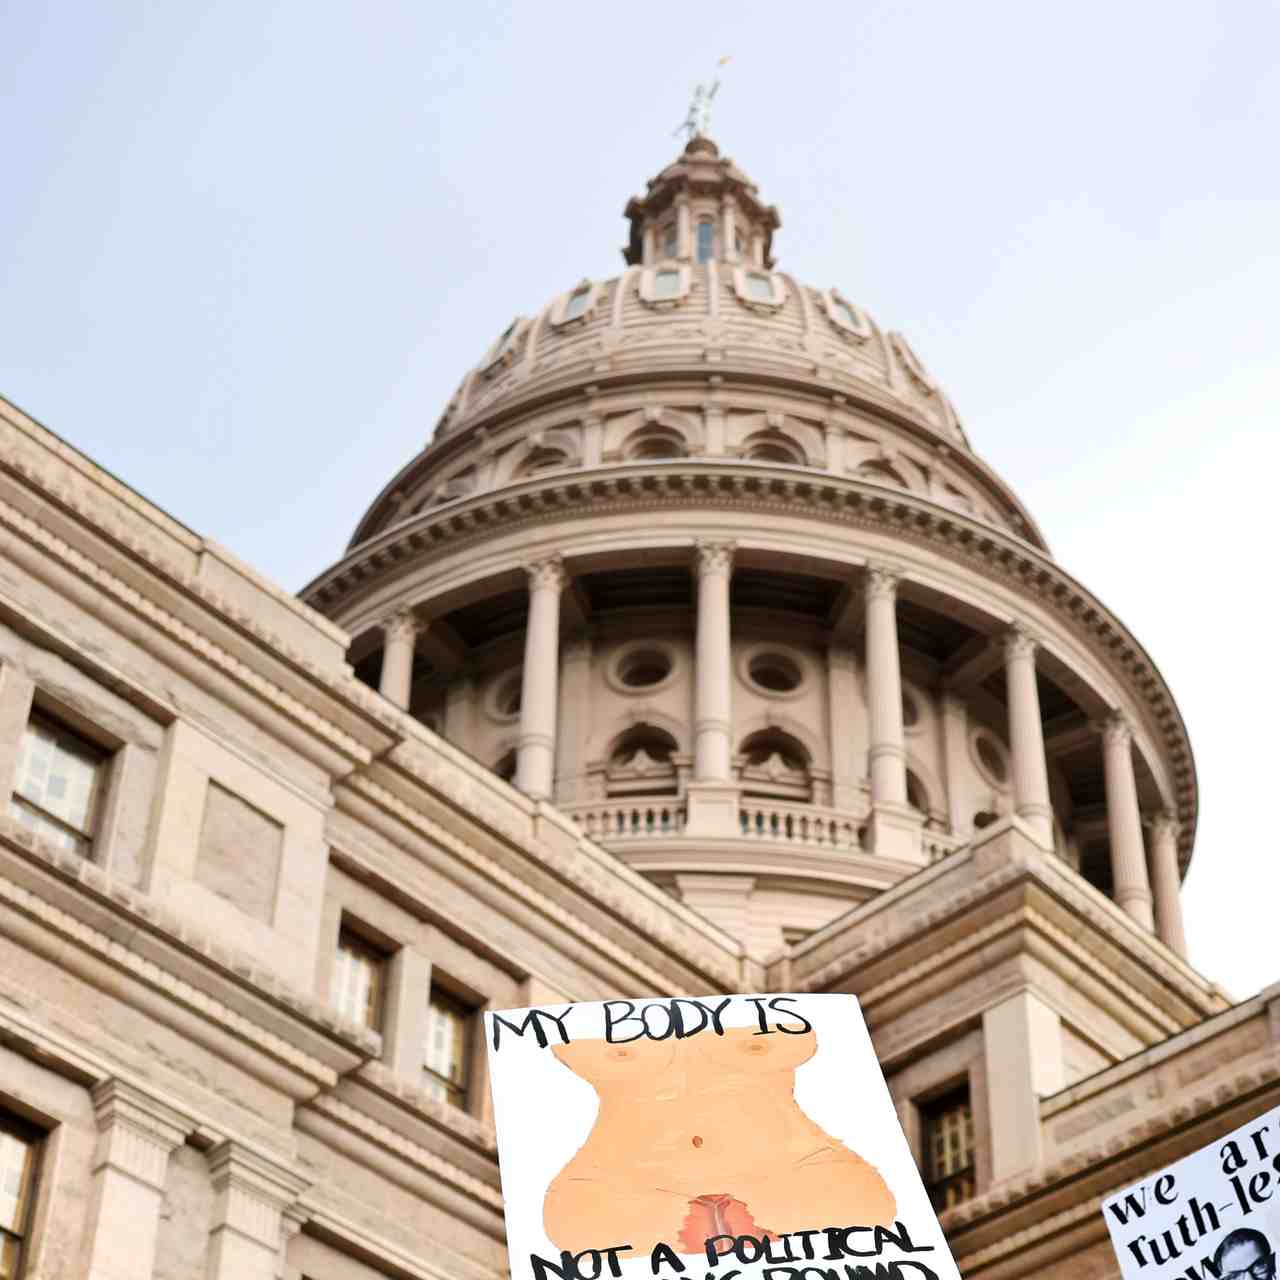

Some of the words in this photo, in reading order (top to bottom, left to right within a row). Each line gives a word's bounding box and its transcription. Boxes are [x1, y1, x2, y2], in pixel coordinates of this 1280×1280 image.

[493, 1007, 575, 1051] MY
[605, 999, 731, 1044] BODY
[745, 998, 812, 1035] IS
[1109, 1173, 1179, 1225] we
[652, 1243, 686, 1275] A
[705, 1221, 935, 1268] POLITICAL
